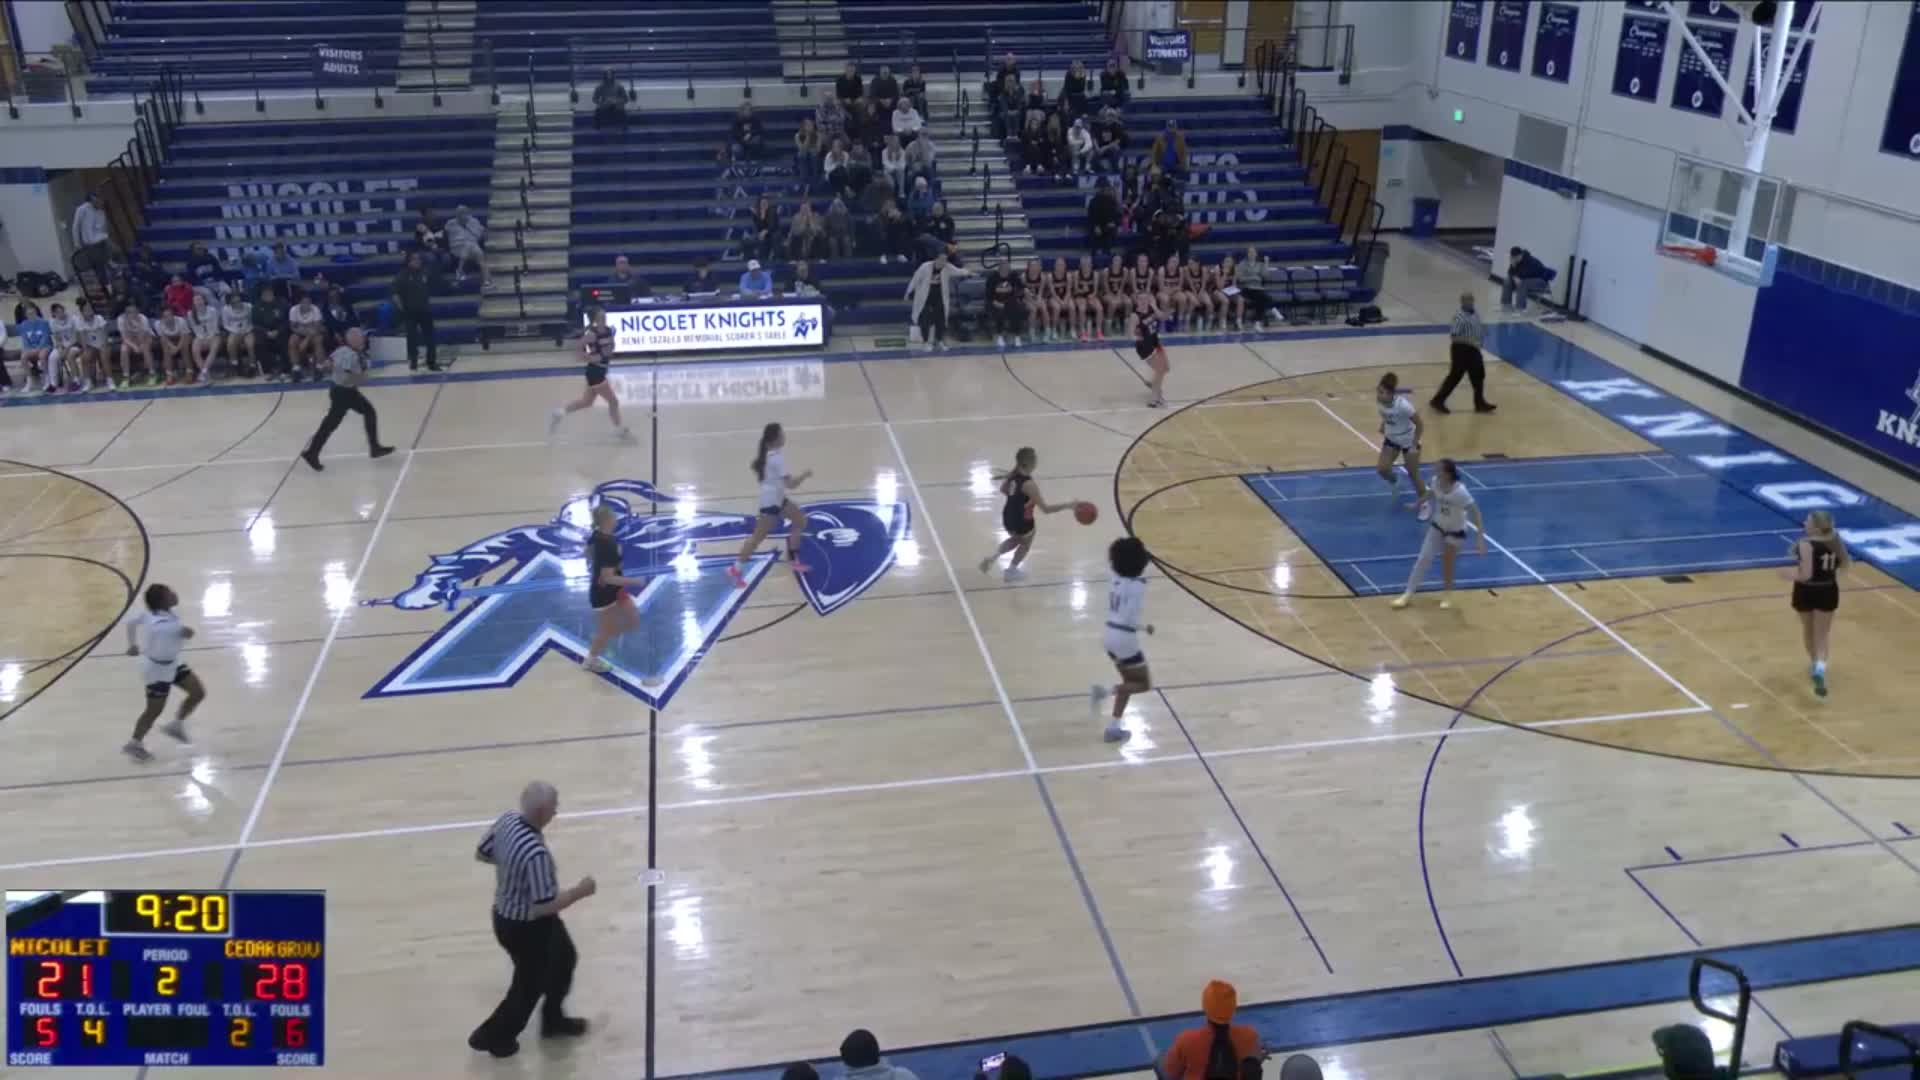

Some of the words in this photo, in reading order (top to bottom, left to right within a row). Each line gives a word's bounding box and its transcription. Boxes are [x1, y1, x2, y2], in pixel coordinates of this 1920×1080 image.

[319, 48, 363, 60] VISITORS
[1147, 48, 1188, 58] STUDENTS
[322, 62, 359, 74] ADULTS
[621, 314, 697, 332] NICOLET
[704, 310, 786, 329] KNIGHTS
